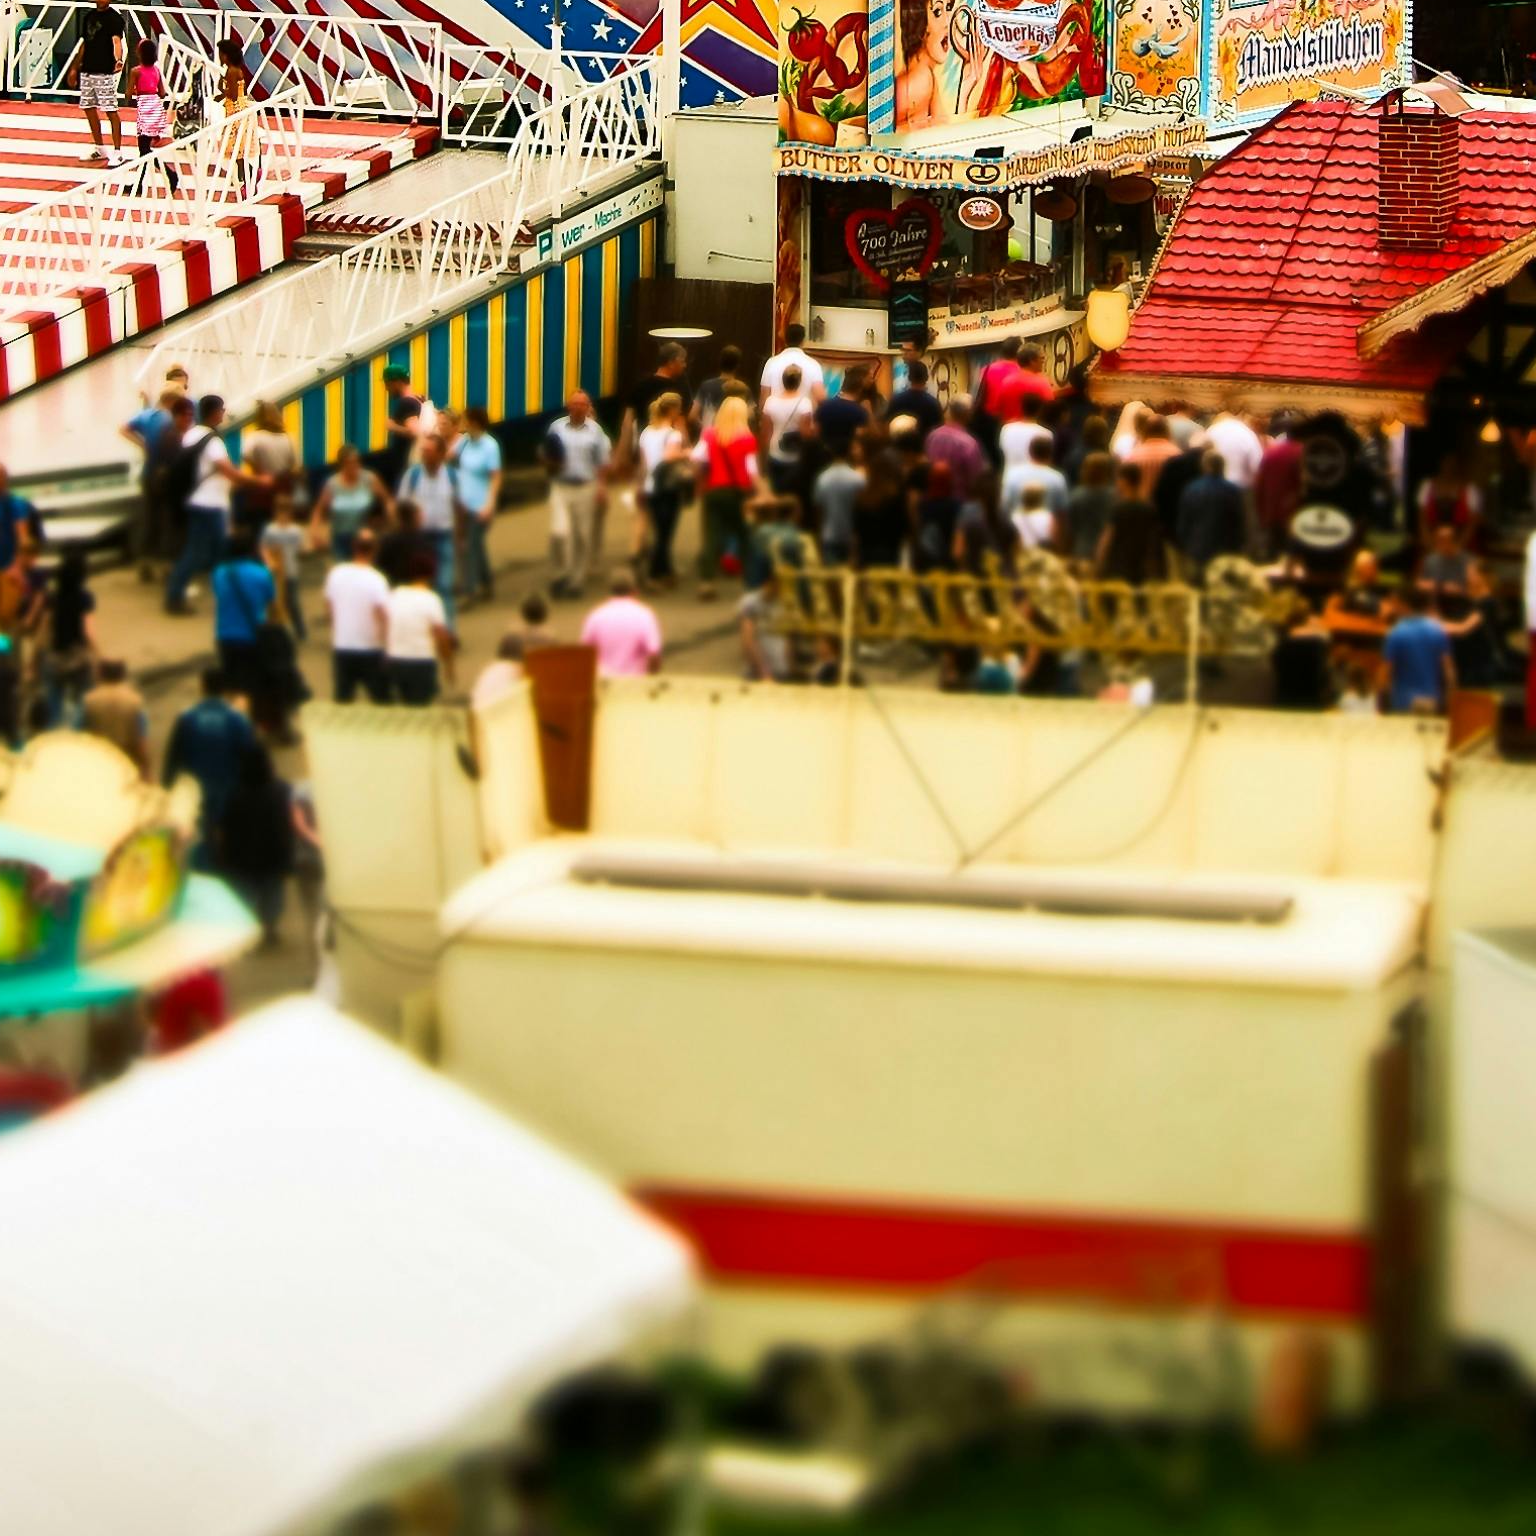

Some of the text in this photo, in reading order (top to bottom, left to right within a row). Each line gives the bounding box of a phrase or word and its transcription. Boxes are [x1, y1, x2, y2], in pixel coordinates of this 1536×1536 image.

[1237, 18, 1382, 84] Mandelstübchen
[780, 149, 863, 173] BUTTER
[873, 155, 954, 181] OLIVEN
[1005, 150, 1058, 182] MARZIPAN
[1063, 145, 1089, 170] SALZ
[1163, 124, 1207, 147] NUTELLA
[890, 223, 928, 248] Jahre
